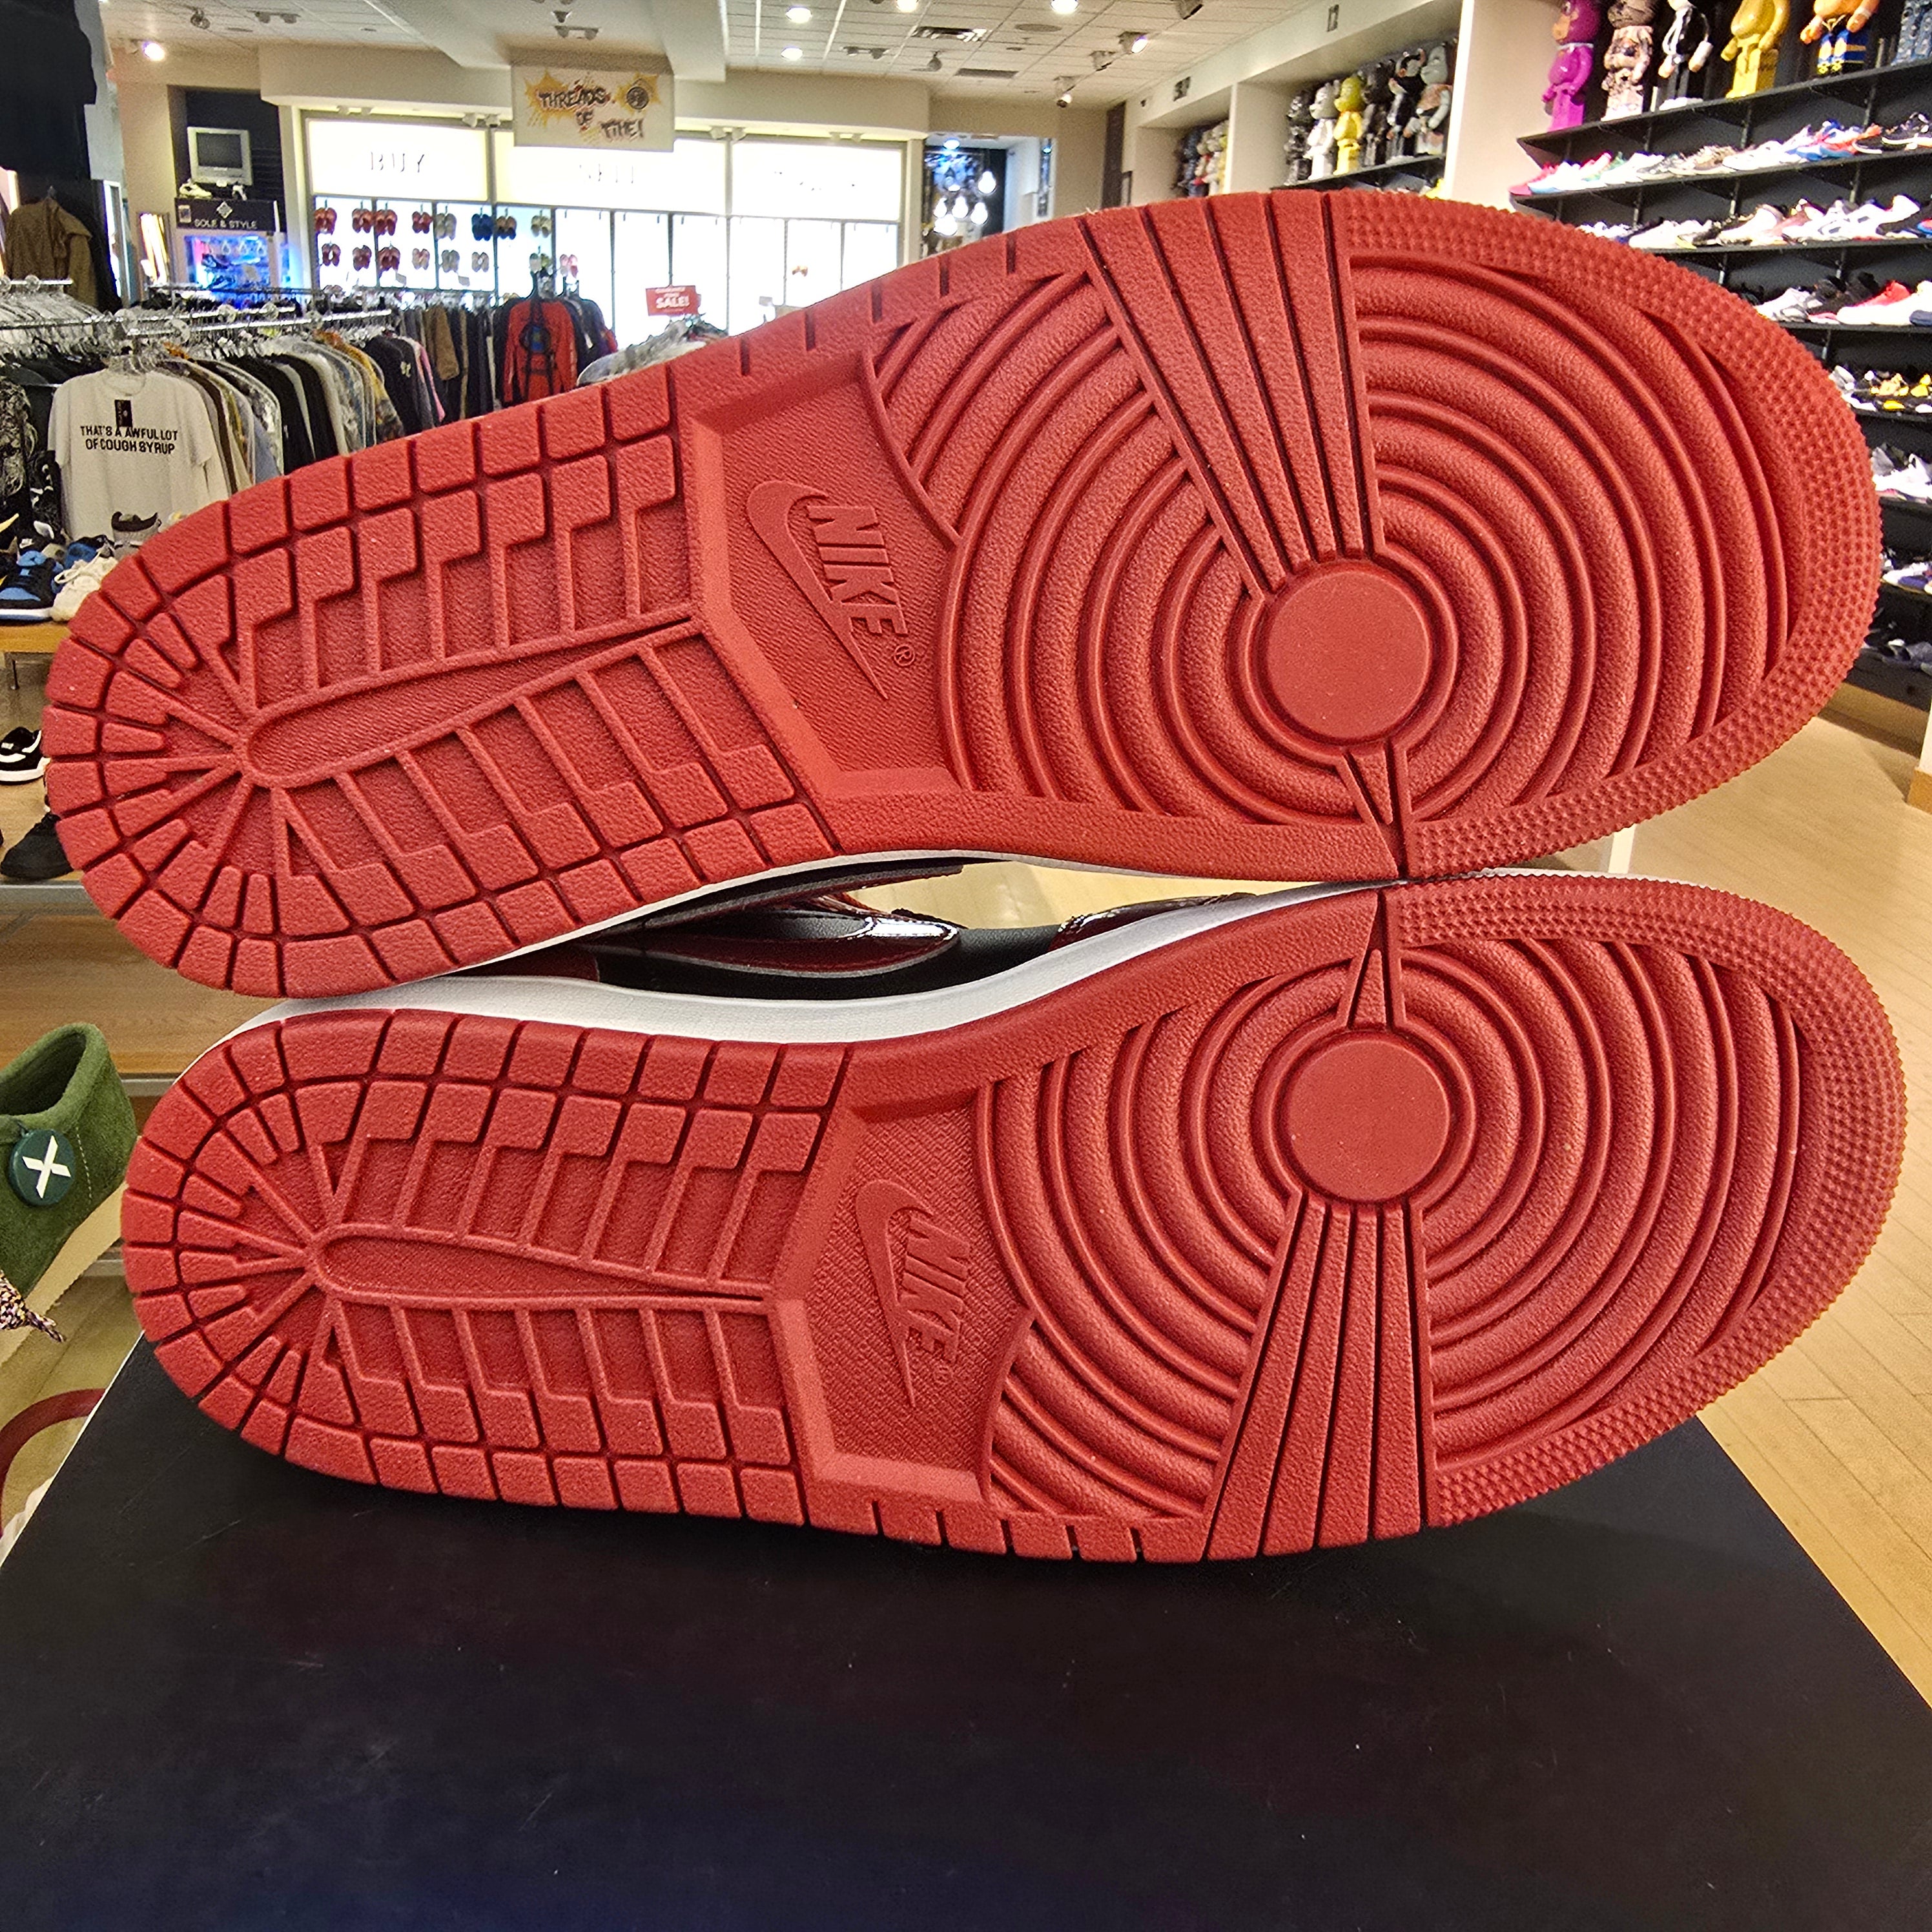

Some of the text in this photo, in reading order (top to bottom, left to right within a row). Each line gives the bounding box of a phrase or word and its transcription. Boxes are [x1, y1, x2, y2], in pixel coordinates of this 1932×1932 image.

[371, 151, 425, 173] BUY
[194, 218, 218, 228] SOLE
[229, 220, 258, 229] STYLE
[81, 426, 178, 440] THAT'S A AWFUL LOT
[85, 438, 175, 455] OF COUGH SYRUP
[807, 505, 909, 635] NIKE
[900, 1215, 969, 1364] NIKE
